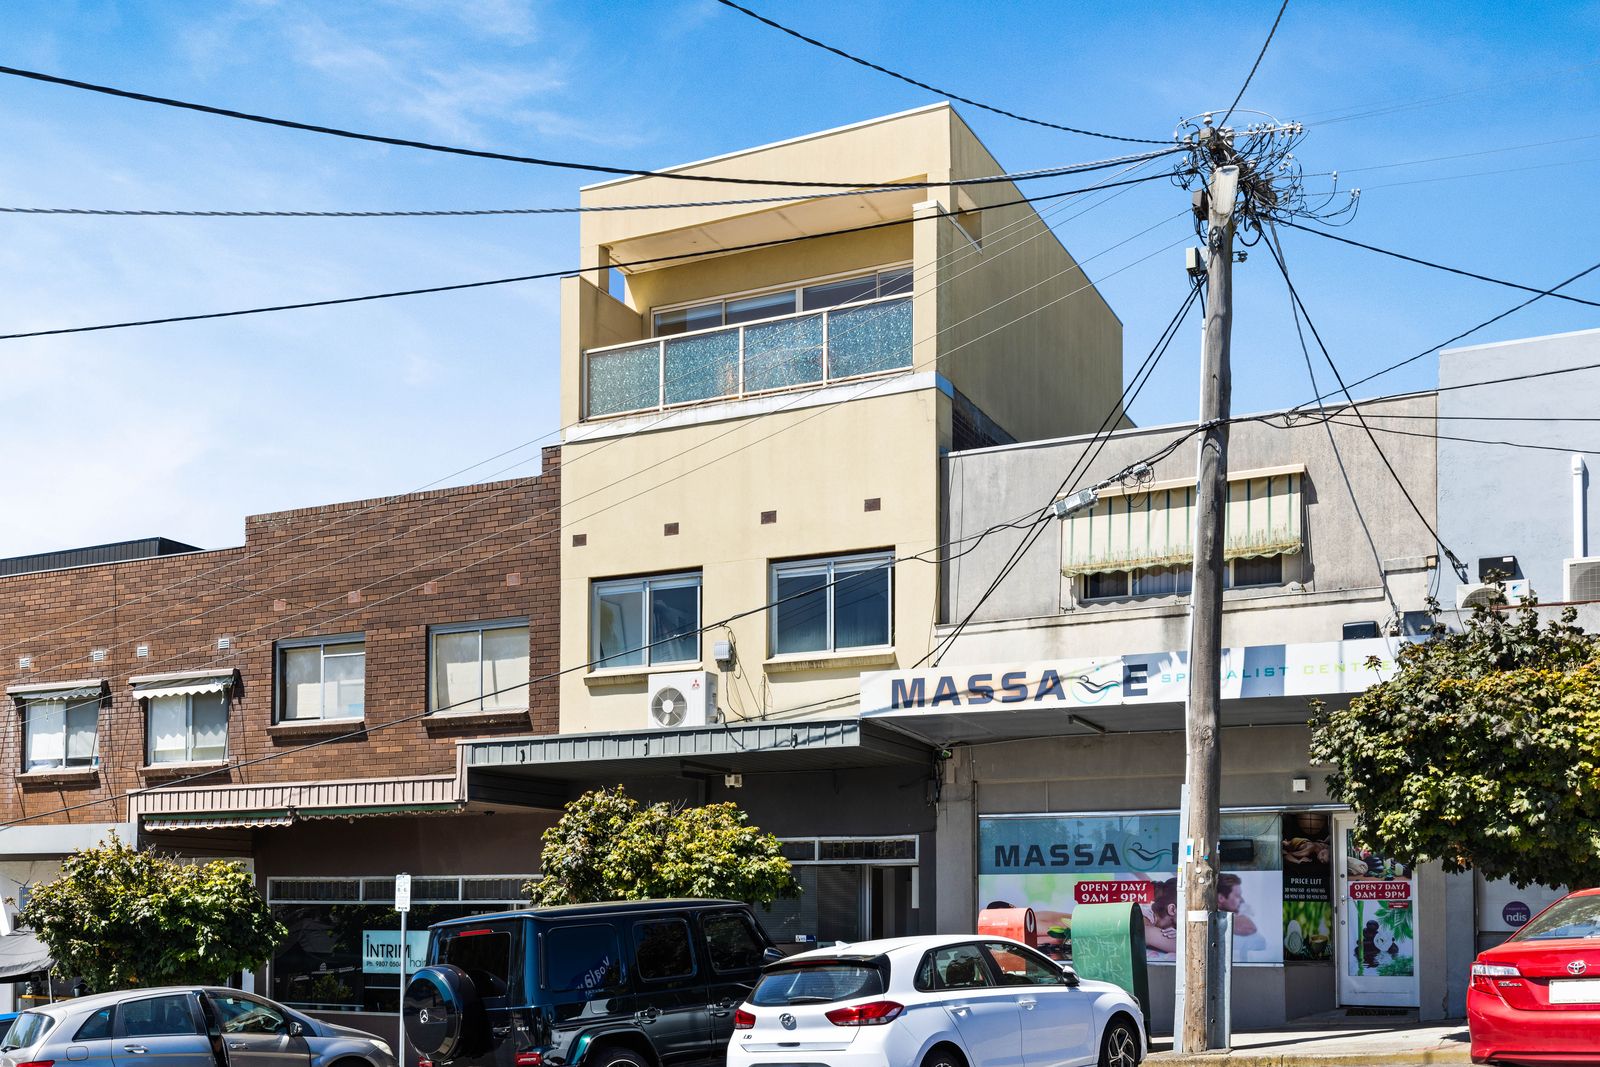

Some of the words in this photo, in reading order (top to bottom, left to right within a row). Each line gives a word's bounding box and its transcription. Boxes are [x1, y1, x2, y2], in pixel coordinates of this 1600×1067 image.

[1161, 667, 1288, 683] SPALIST
[1080, 883, 1109, 892] OPEN
[1112, 883, 1118, 892] 7
[1121, 883, 1147, 892] DAYS
[1081, 893, 1109, 902] 9AM
[1120, 893, 1147, 902] 9PM
[1355, 891, 1376, 899] 9AM
[1384, 891, 1405, 899] 9PM
[1506, 912, 1527, 922] ndis
